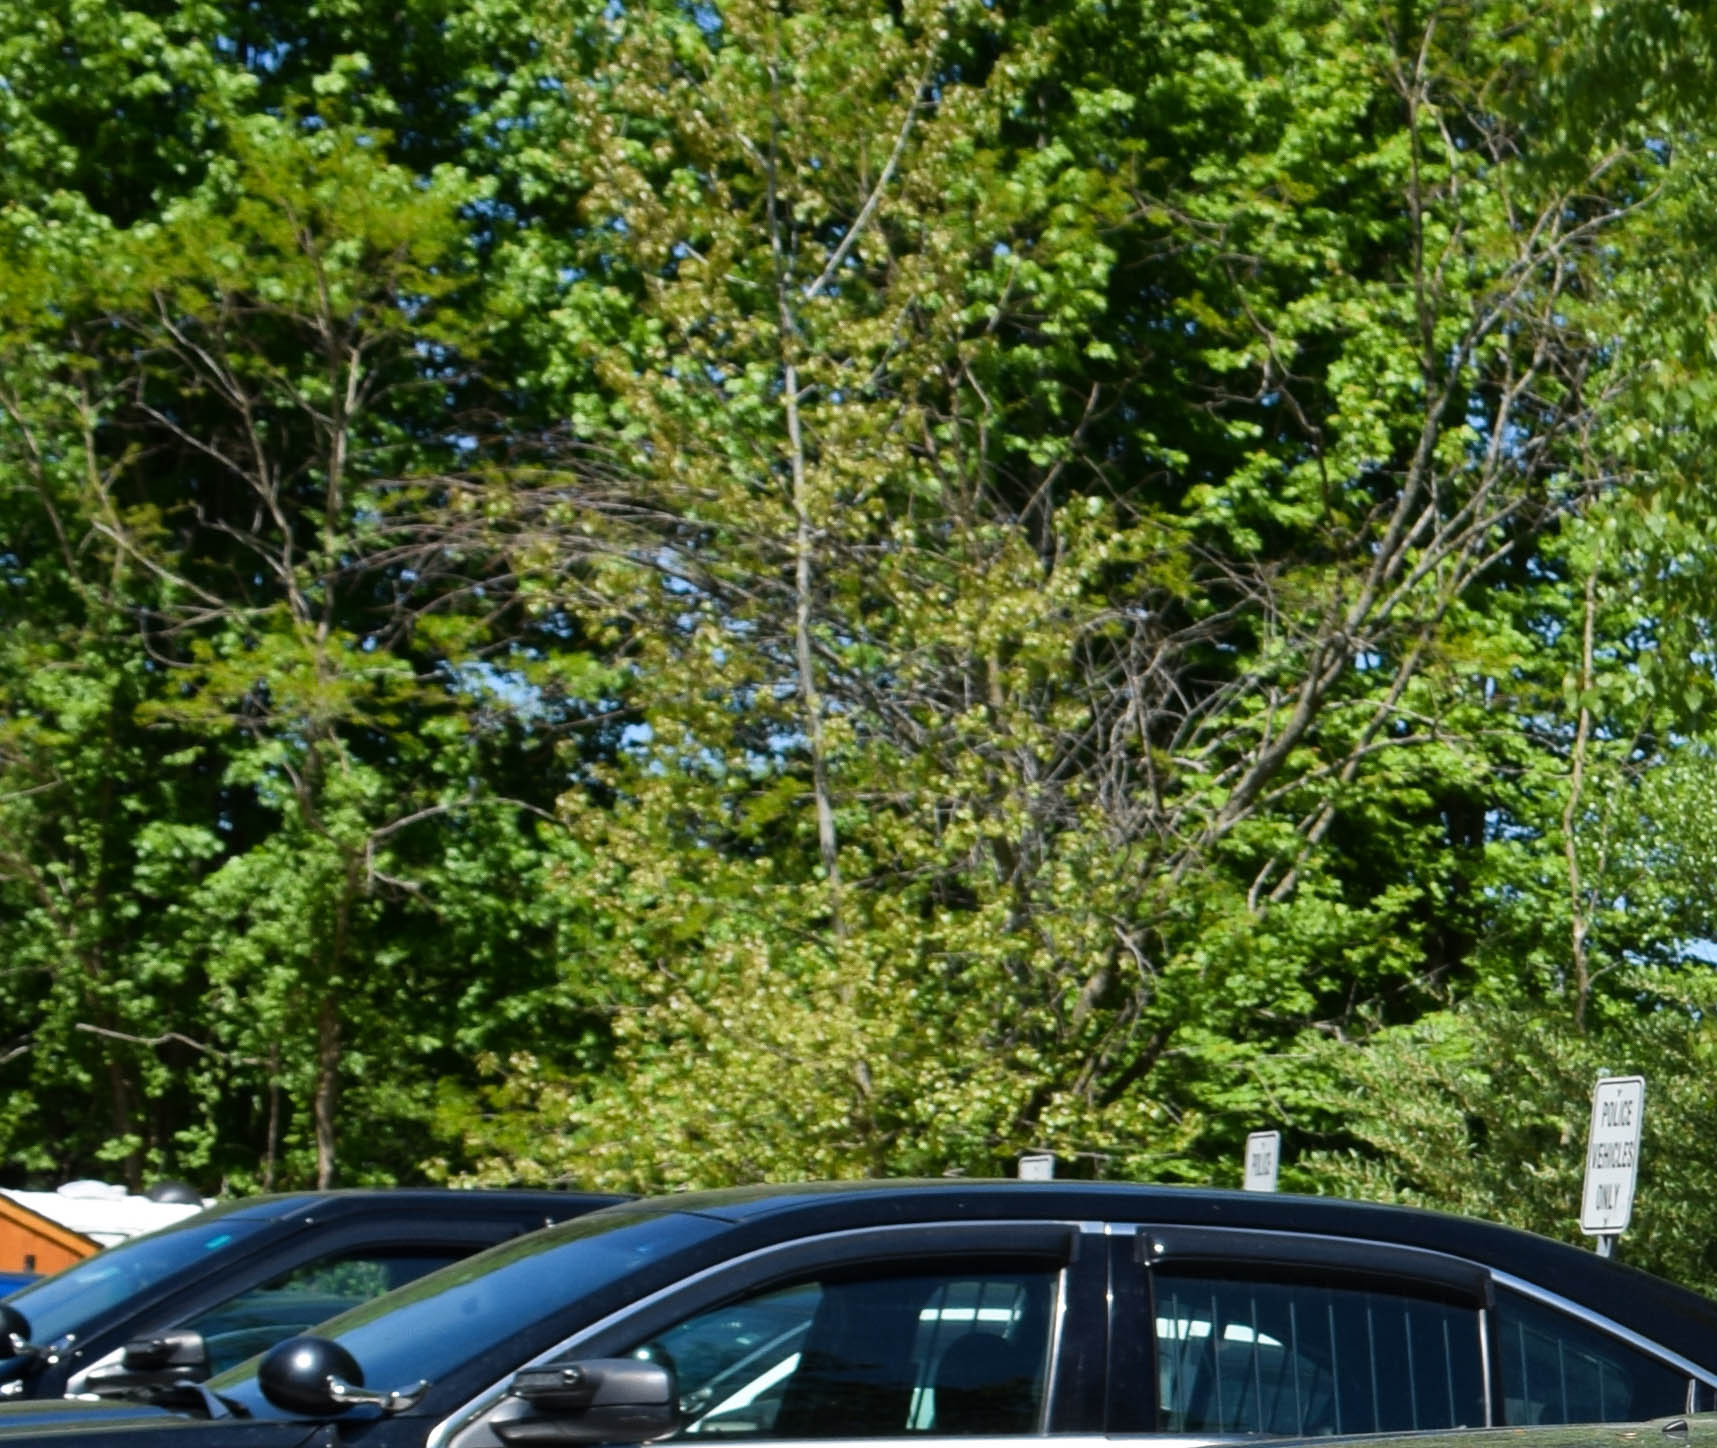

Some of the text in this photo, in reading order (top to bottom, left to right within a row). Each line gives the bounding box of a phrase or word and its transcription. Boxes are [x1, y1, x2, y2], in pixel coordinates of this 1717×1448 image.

[1601, 1100, 1633, 1127] POLICE
[1592, 1142, 1634, 1168] VEHICLES
[1596, 1184, 1620, 1210] ONLY
